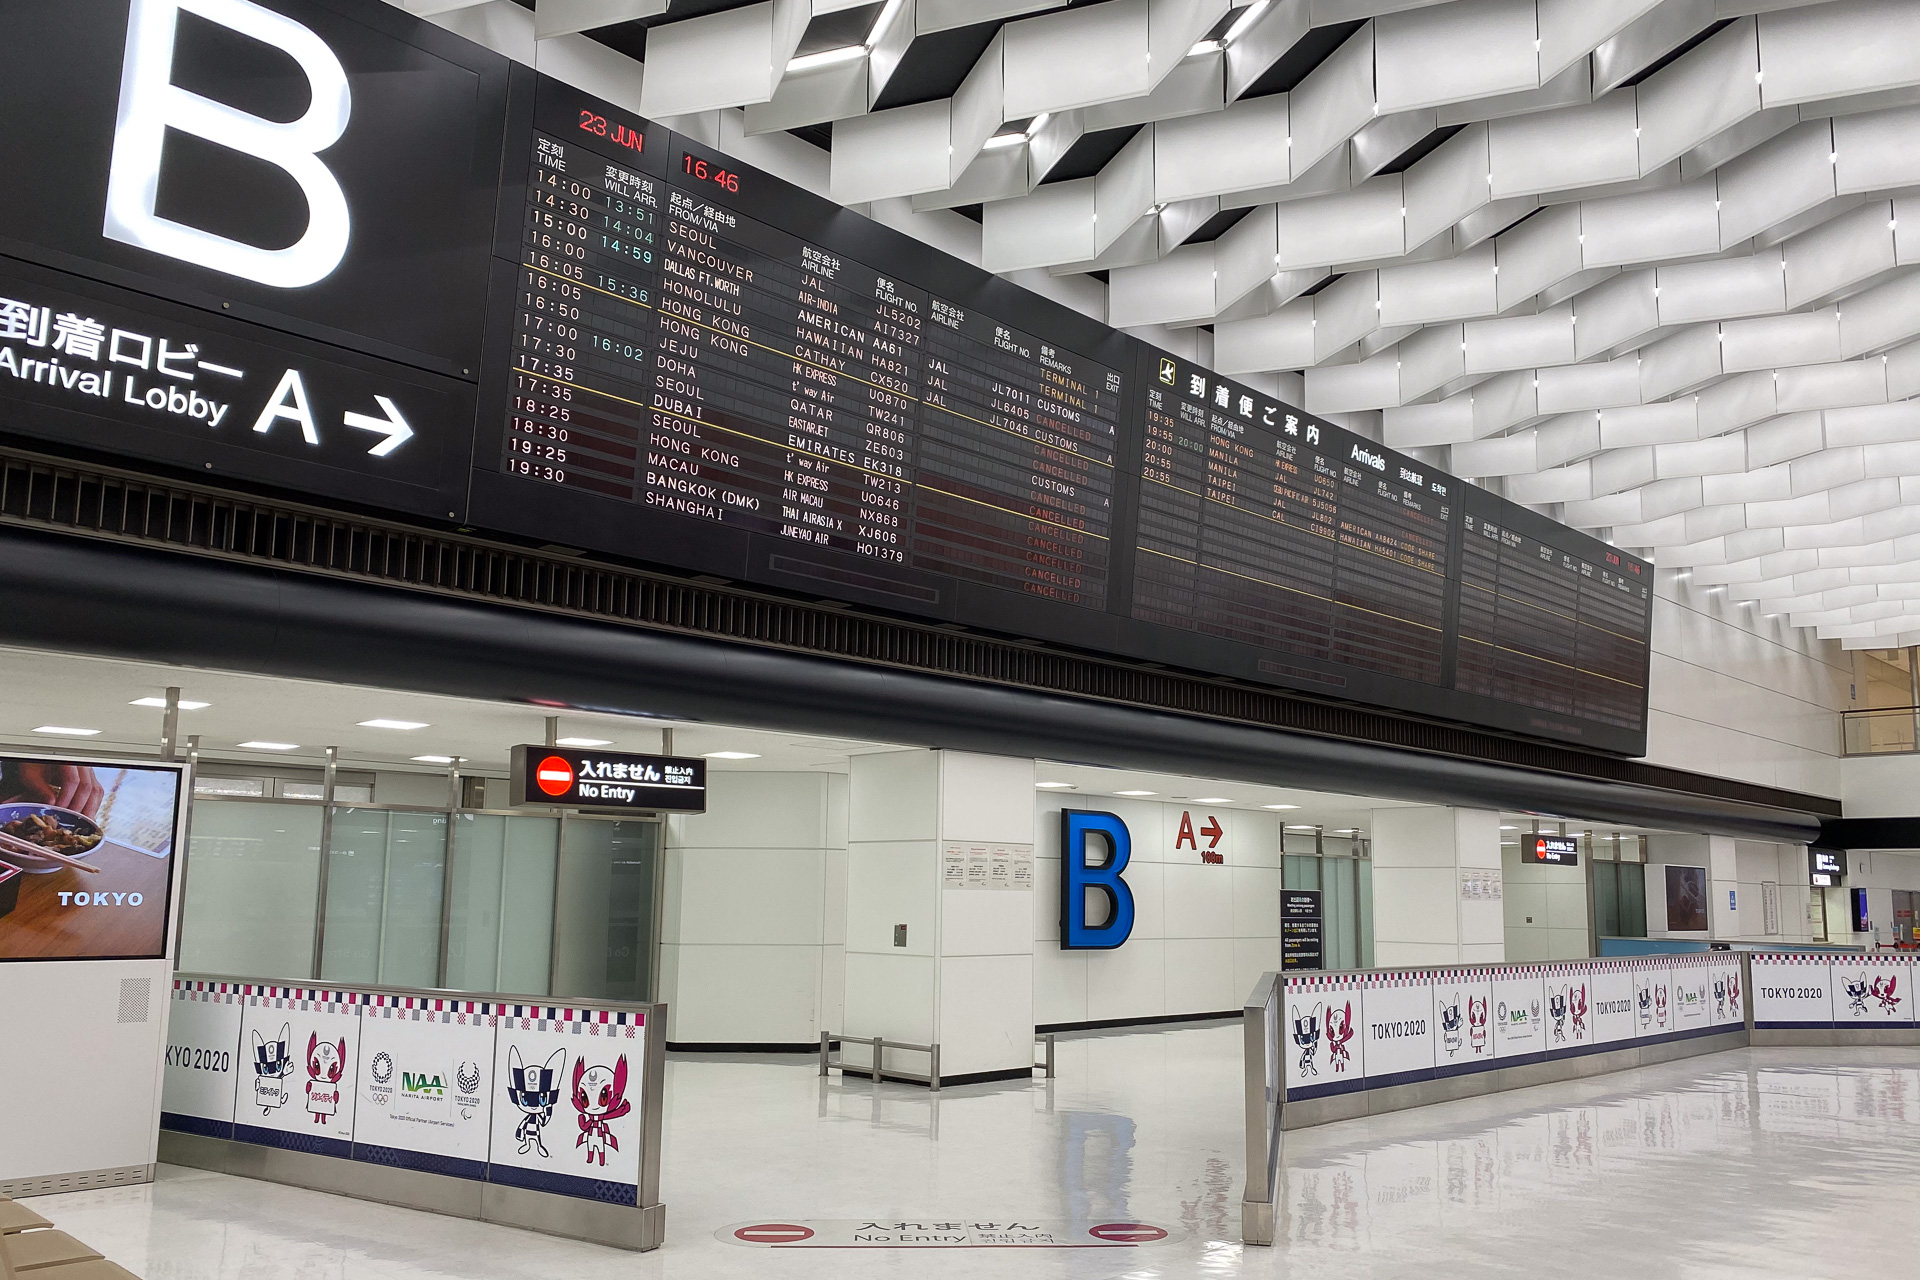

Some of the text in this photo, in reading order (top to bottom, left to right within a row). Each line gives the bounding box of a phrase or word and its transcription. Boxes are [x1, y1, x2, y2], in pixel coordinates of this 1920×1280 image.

[102, 0, 352, 288] B
[579, 110, 643, 152] 23 JUN
[537, 138, 564, 158] 定刻
[537, 151, 566, 172] TIME
[605, 165, 653, 194] 変更時刻
[605, 178, 658, 208] WILL ARR.
[669, 204, 718, 232] FROM/VIA
[536, 190, 920, 346] 14:30 14:04 VANCOUVER AIR-INDIA AI7327
[801, 258, 834, 280] AIRLINE
[802, 246, 841, 271] 航空会社
[538, 170, 1088, 396] 14:00 13:51 SEOUL JAL JL5202 TERMINAL
[875, 288, 903, 307] FLIGHT
[534, 211, 1081, 423] 15:00 14:59 DALLAS FT.WORTH AMERICAN AA61 JAL JL7011 CUSTOMS
[0, 296, 244, 381] 到着ロビー
[527, 272, 907, 410] 16:05 HK EXPRESS UO870
[529, 251, 1029, 435] 16:05 15:36 HONG KONG CATHAY CX520 JL7046
[532, 231, 1091, 441] 16:00 HONOLULU HAWAIIAN HA821 JL6405 CANCELLED
[525, 293, 904, 427] 16:50 JEJU TW241
[1039, 355, 1072, 375] REMARKS
[0, 347, 229, 428] Arrival Lobby
[1105, 382, 1120, 394] EXIT
[1106, 372, 1121, 385] 出口
[252, 368, 320, 446] A
[521, 334, 904, 461] 17:30 SEOUL EASTARJET ZE603
[524, 313, 1075, 497] 17:00 16:02 DOHA QATAR QR806 CUSTOMS
[517, 375, 901, 494] 17:35 SEOUL TW213
[519, 354, 1085, 530] 17:35 DUBAI EMIRATES EK318 CANCELLED
[1145, 438, 1172, 455] 20:00
[1148, 425, 1173, 442] 19:55
[1178, 436, 1203, 453] 20:00
[1209, 448, 1239, 466] MANILA
[1149, 411, 1174, 428] 19:35
[1210, 434, 1230, 449] HONG
[1234, 444, 1254, 458] KONG
[513, 417, 898, 527] 18:30 MACAU AIR MACAU NX868
[1144, 453, 1171, 469] 20:55
[1208, 474, 1236, 492] TAIPEI
[1351, 444, 1385, 471] Arrivals
[515, 396, 1083, 560] 18:25 UO646 CANCELLED
[1143, 466, 1170, 483] 20:55
[511, 438, 897, 544] 19:25 BANGKOK (DMK) THAI AIRASIA XJ606
[509, 458, 903, 563] 19:30 SHANGHAI JUNEYAO AIR HO1379
[578, 760, 661, 782] 入れません
[579, 783, 635, 803] No Entry
[1175, 810, 1198, 851] A
[1060, 807, 1135, 950] B
[58, 890, 145, 908] TOKYO
[1596, 1000, 1631, 1015] TOKYO 2020
[1761, 987, 1822, 999] TOKYO 2020
[1372, 1019, 1426, 1040] TOKYO 2020
[194, 1049, 230, 1073] 2020
[369, 1085, 393, 1094] TOKYO 2020
[401, 1071, 448, 1096] NAA
[455, 1095, 468, 1103] TOKYO
[854, 1234, 967, 1243] No Entry
[856, 1222, 1040, 1231] 入れません
